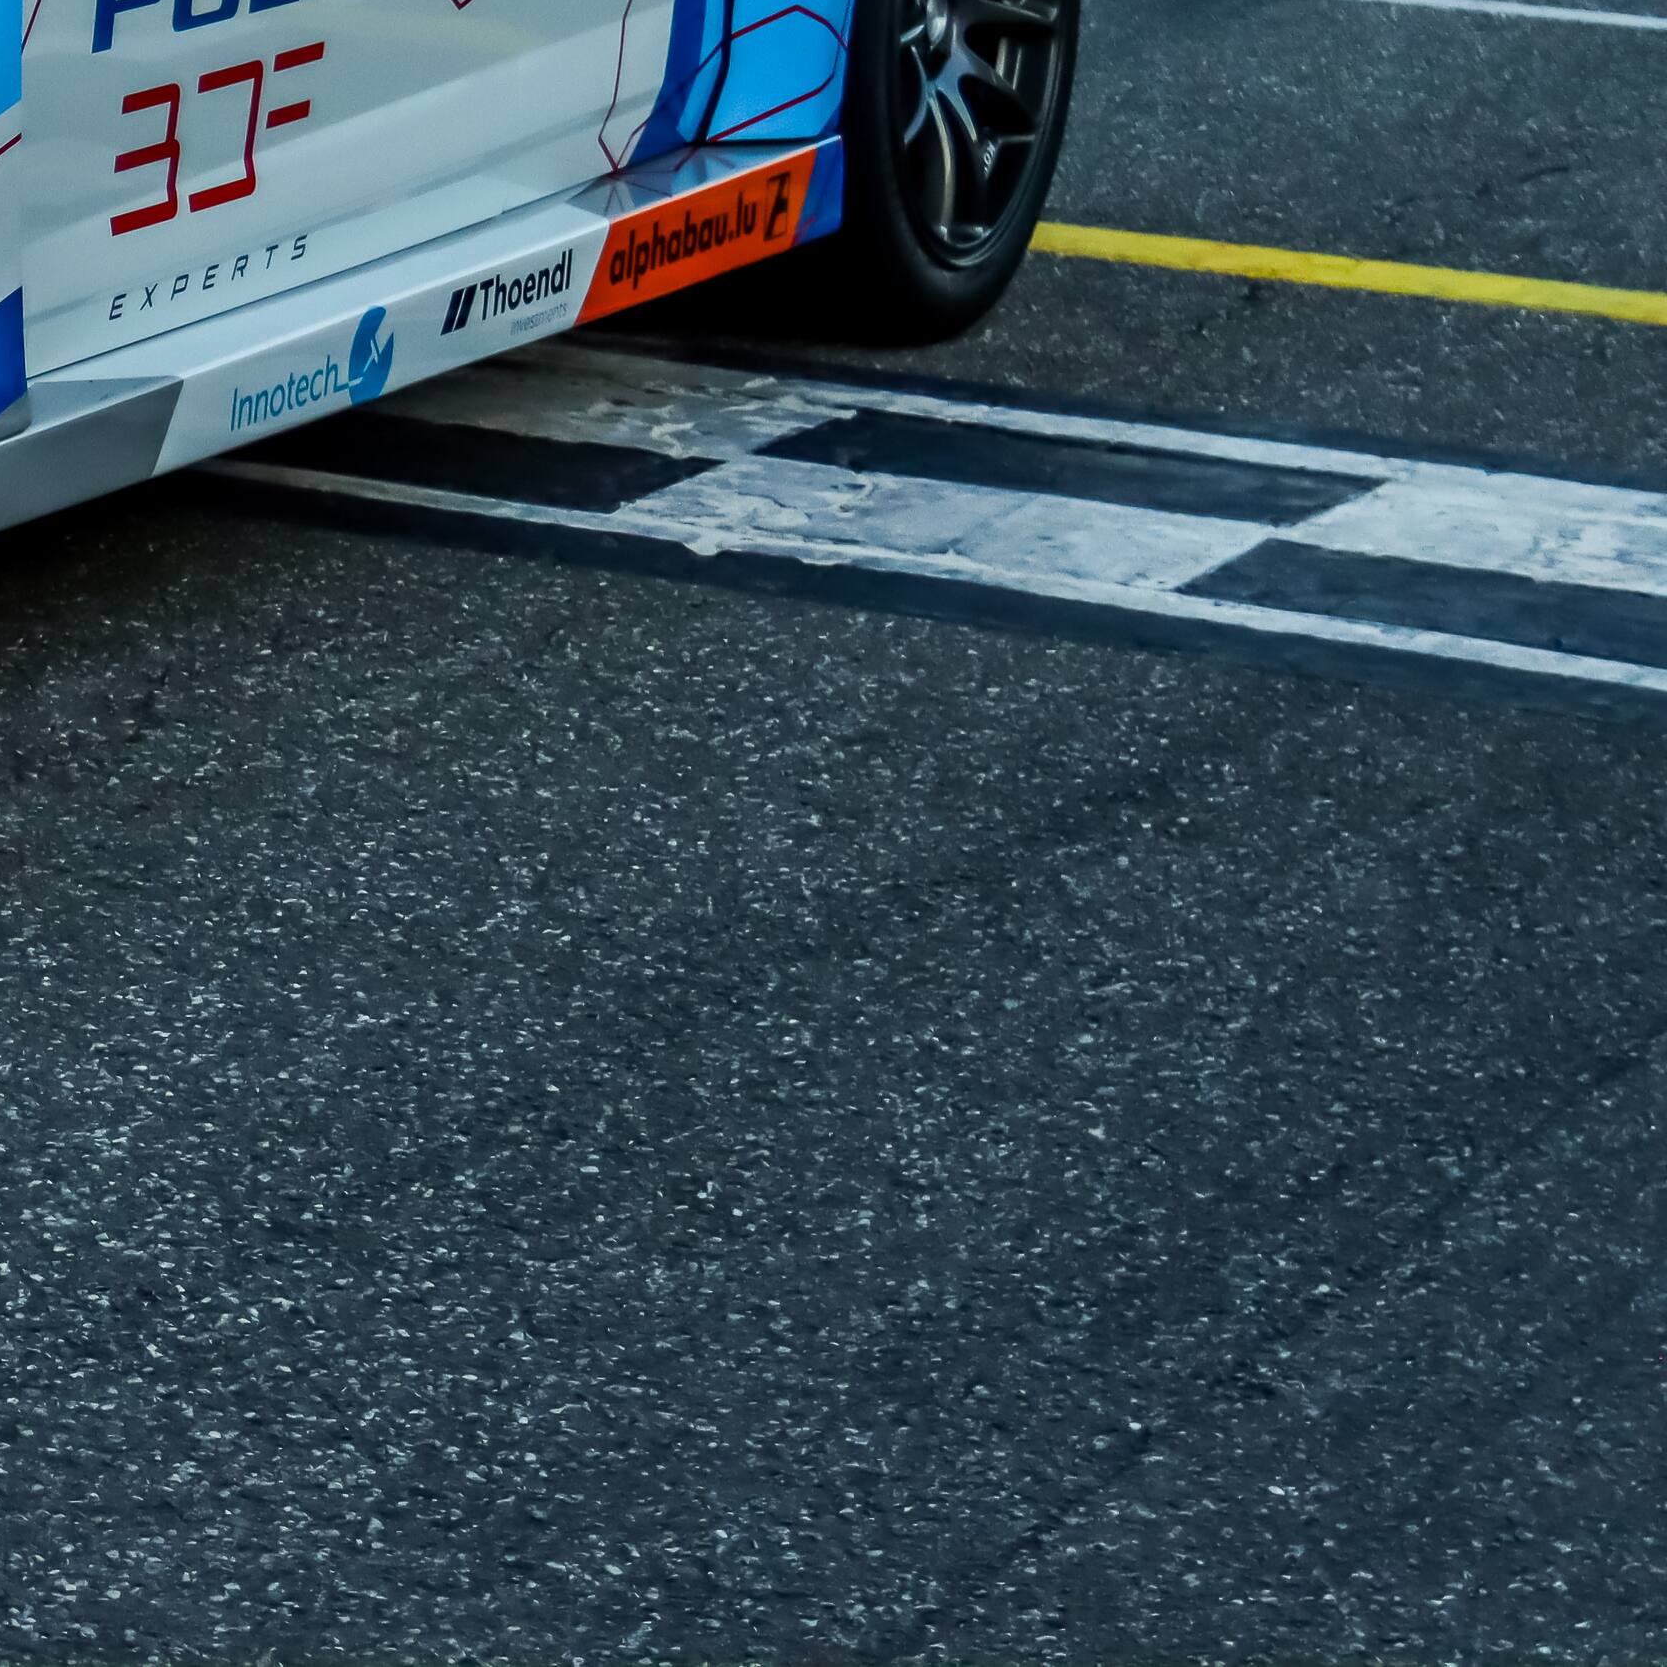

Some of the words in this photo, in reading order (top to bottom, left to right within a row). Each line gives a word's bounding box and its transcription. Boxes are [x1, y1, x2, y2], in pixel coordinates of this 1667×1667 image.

[108, 234, 308, 321] EXPERTS
[609, 190, 757, 290] alphabau.lu
[479, 248, 574, 321] Thoendl
[230, 354, 344, 432] Innotech
